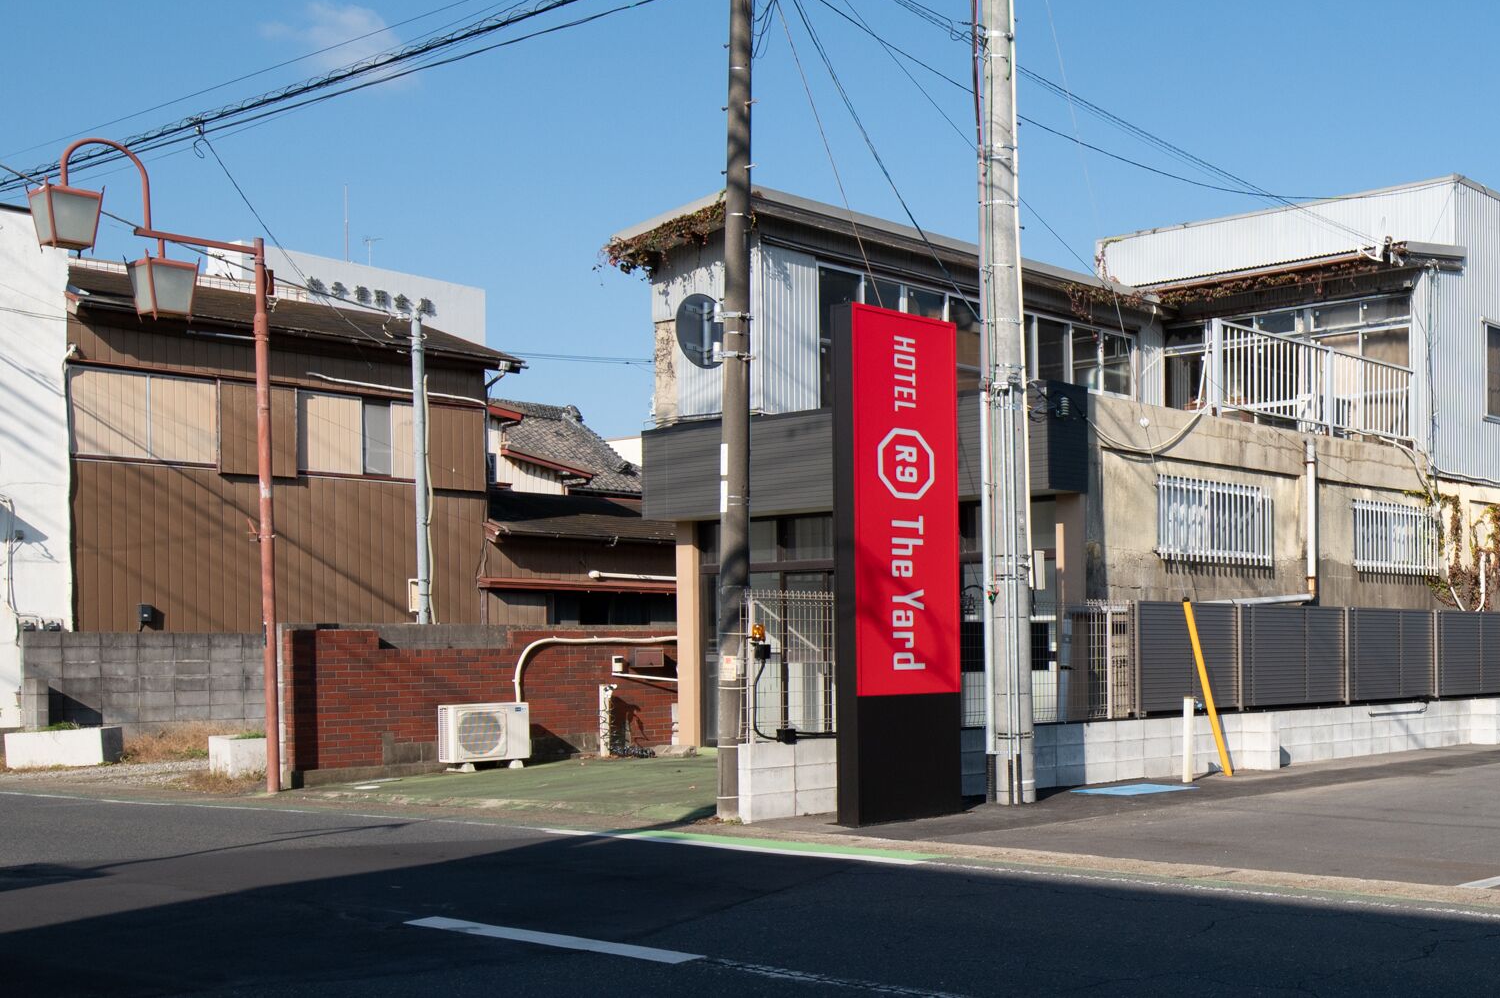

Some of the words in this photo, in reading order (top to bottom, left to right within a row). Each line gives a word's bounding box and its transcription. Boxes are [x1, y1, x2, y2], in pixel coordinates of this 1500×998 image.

[893, 335, 916, 412] HOTEL
[895, 443, 918, 484] R9
[891, 516, 924, 578] The
[891, 588, 926, 672] Yard
